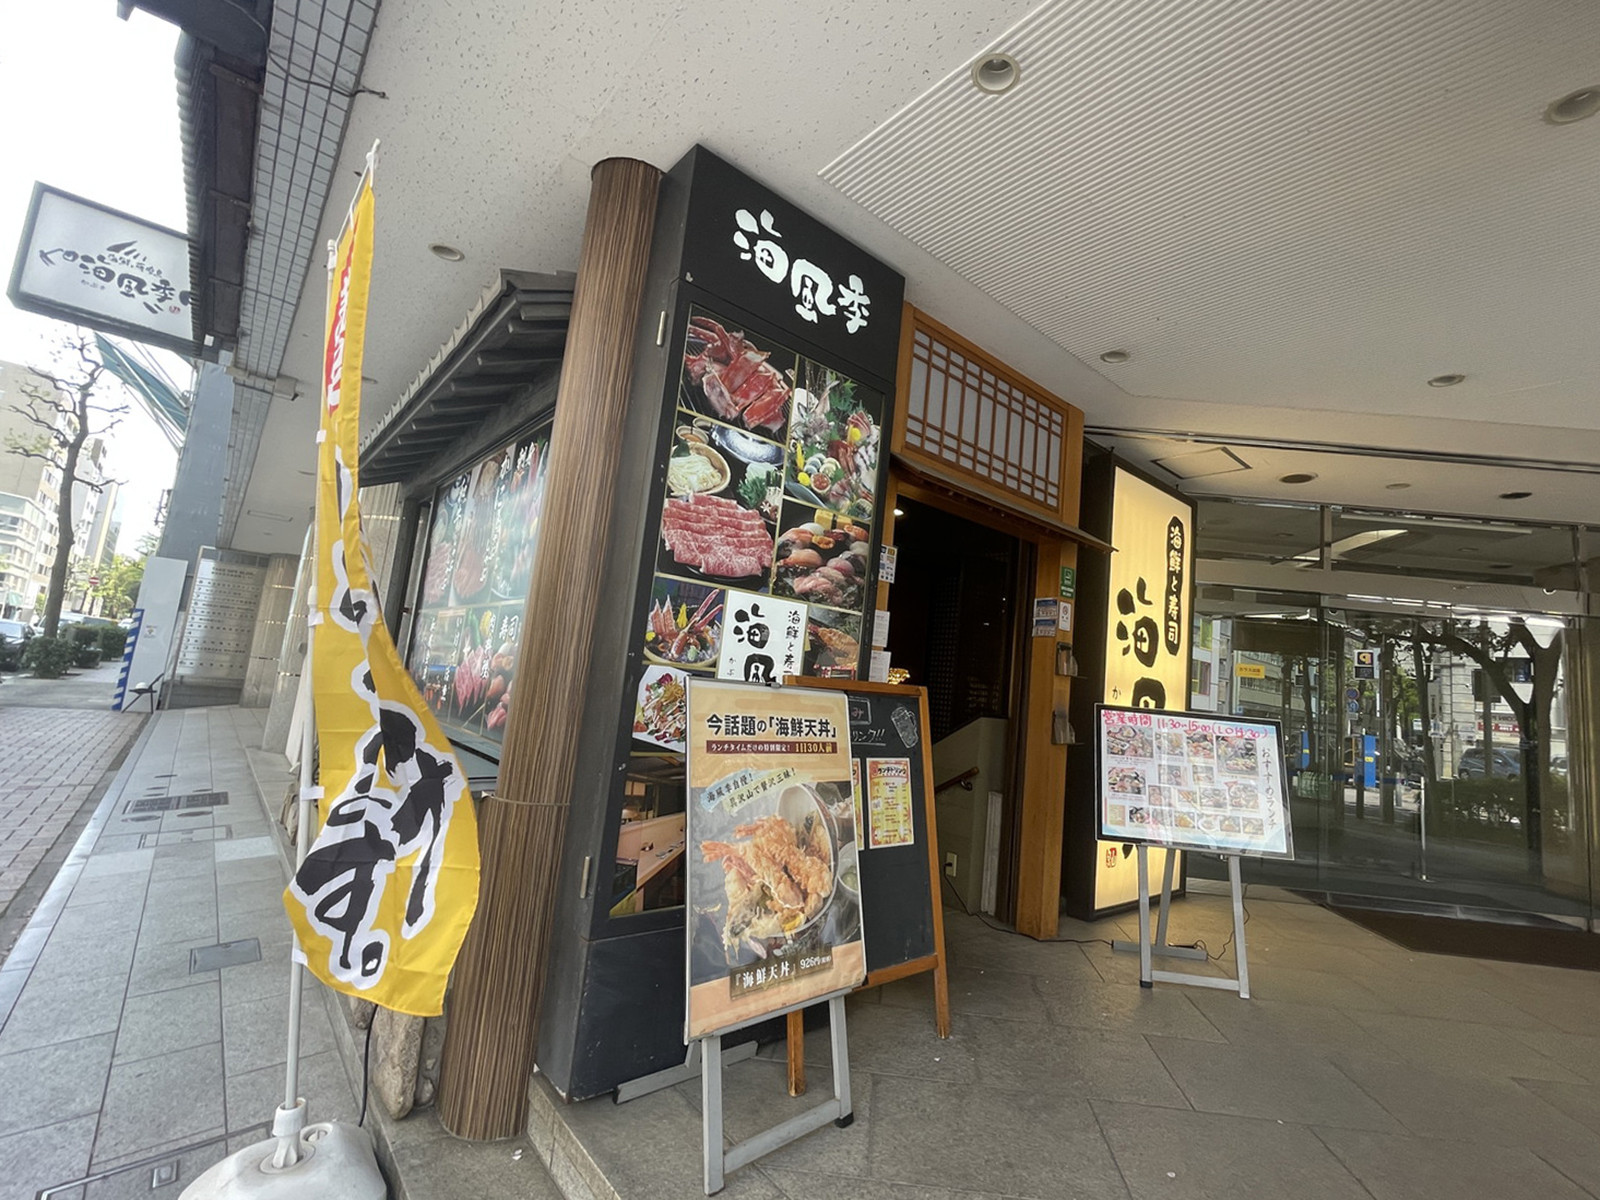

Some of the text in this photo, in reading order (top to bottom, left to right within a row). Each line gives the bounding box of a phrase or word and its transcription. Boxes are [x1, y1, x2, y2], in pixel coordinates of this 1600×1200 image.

[734, 209, 870, 333] 海風季
[1169, 525, 1183, 645] 海鮮と寿司
[782, 610, 801, 675] 海鮮と寿
[707, 714, 837, 738] 今話題の「海鮮天丼」
[1102, 710, 1152, 727] 営業時間
